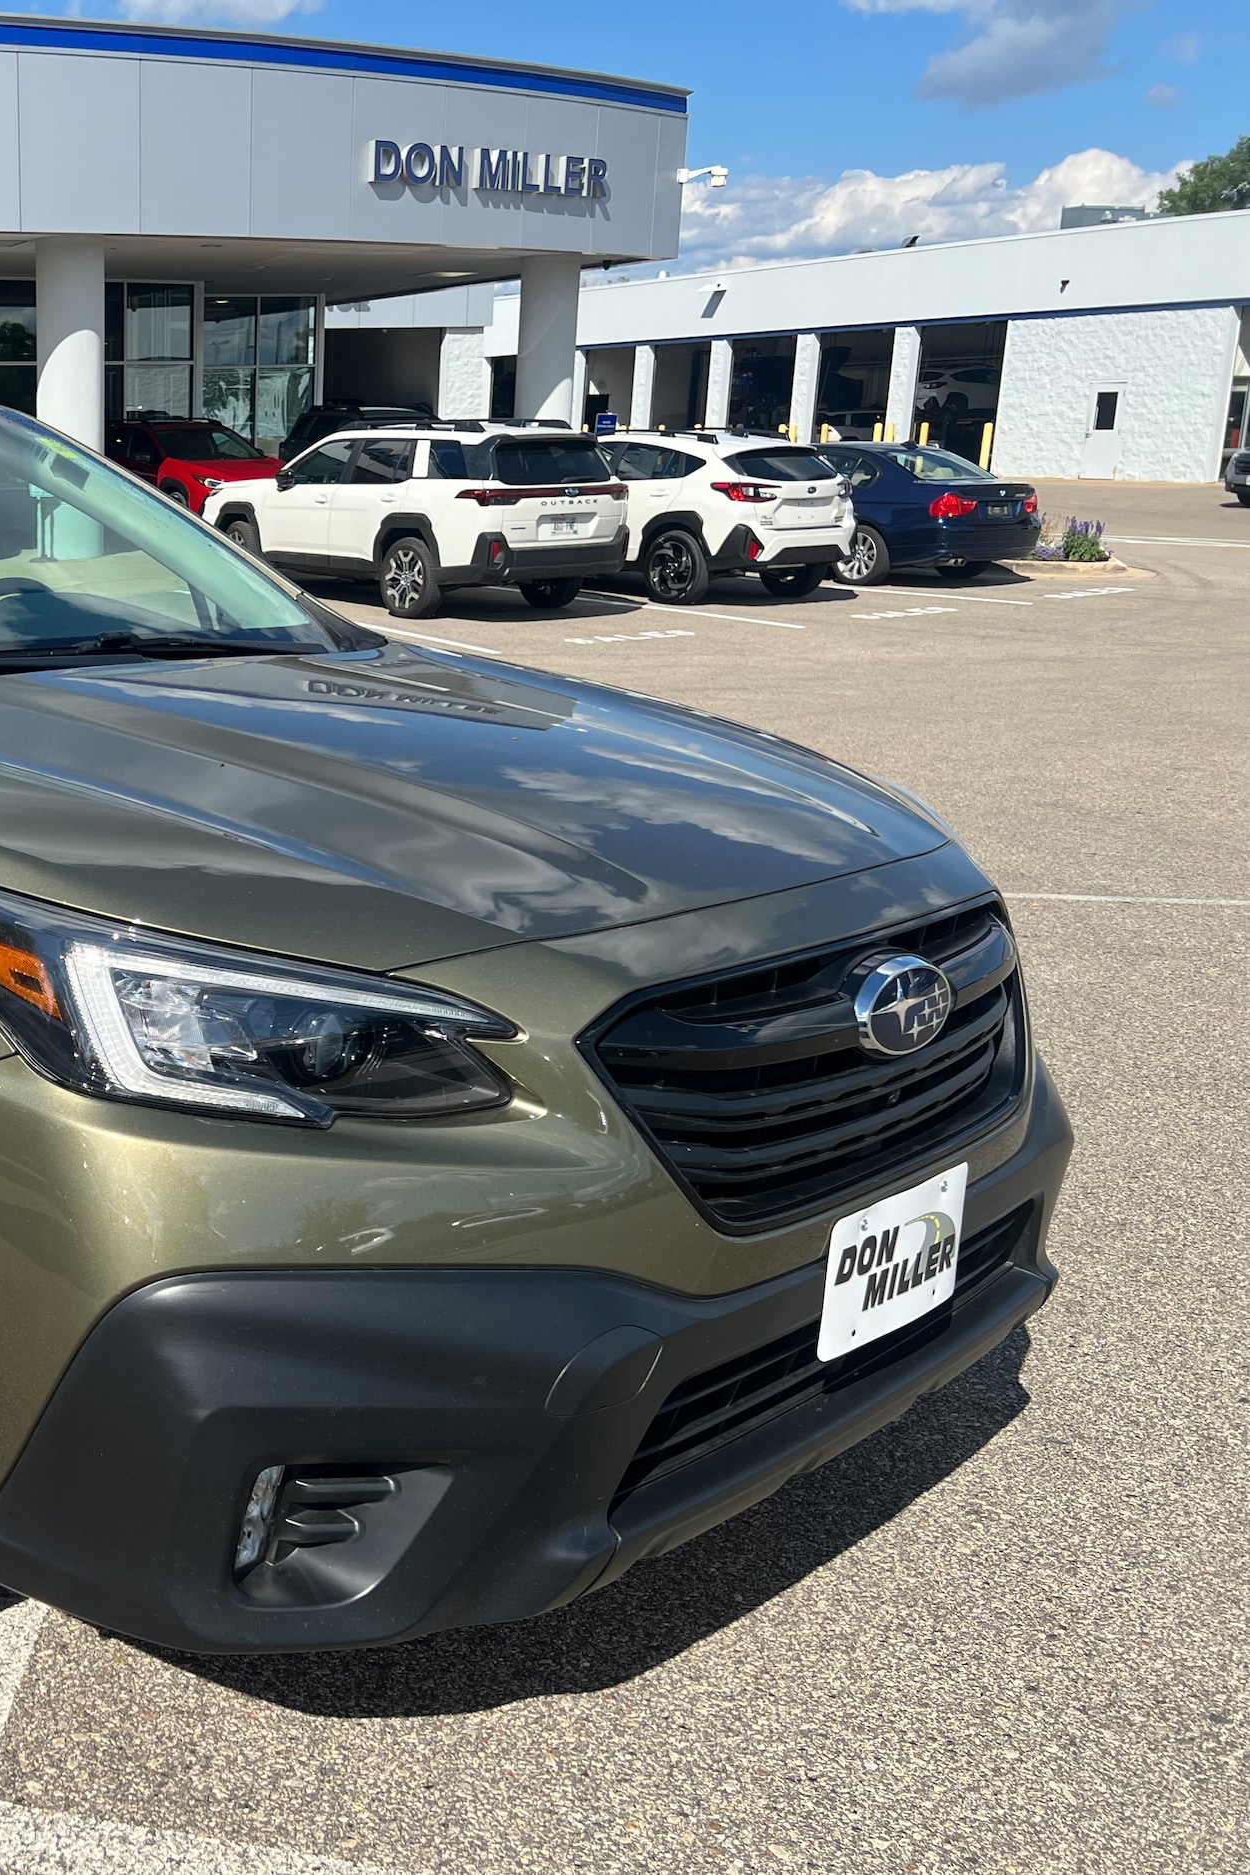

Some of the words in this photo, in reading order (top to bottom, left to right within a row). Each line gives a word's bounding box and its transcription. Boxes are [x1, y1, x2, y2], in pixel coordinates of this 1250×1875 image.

[370, 139, 464, 187] DON
[474, 147, 608, 198] MILLER
[540, 498, 599, 507] OUTBACK
[564, 629, 695, 644] SALES
[834, 1225, 900, 1286] DON
[861, 1233, 956, 1313] MILLER
